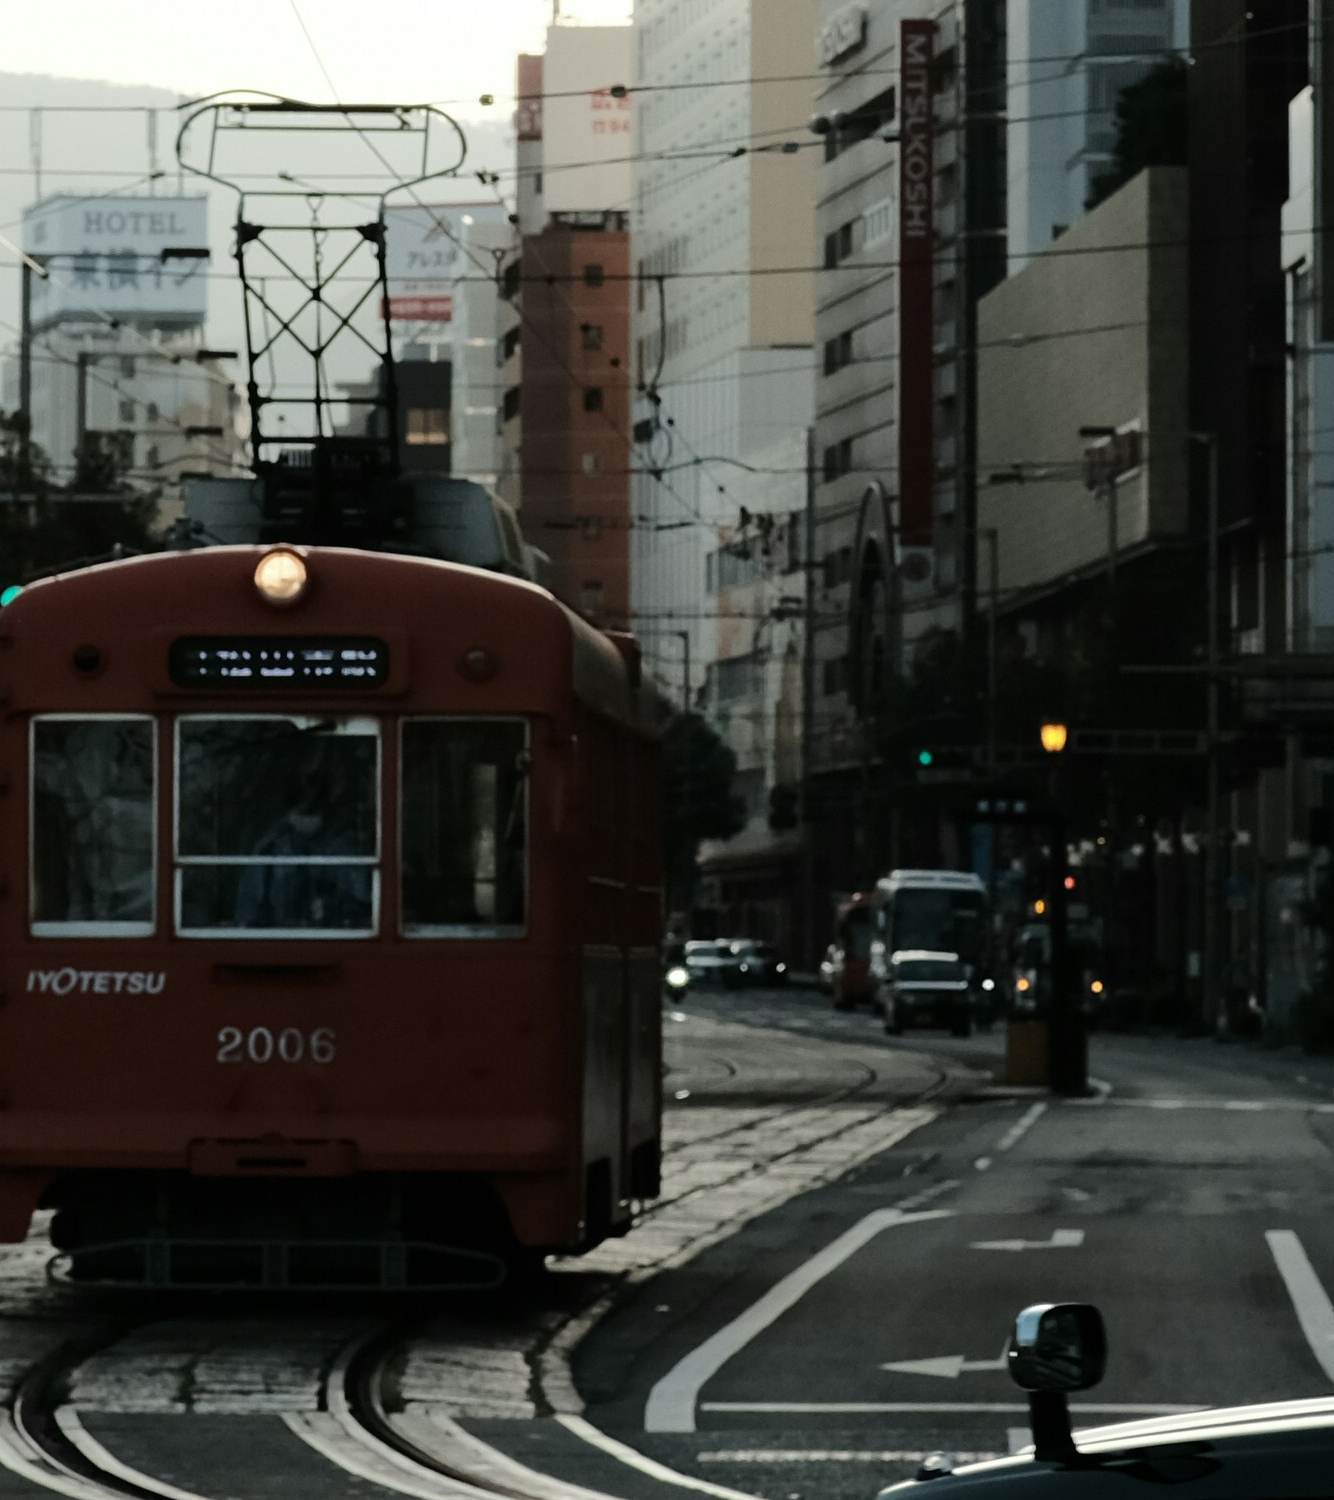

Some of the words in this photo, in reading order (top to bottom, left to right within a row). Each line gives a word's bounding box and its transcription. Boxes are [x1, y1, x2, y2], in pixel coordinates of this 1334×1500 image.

[904, 31, 929, 237] MITSUKOSHI
[83, 211, 186, 234] HOTEL
[26, 967, 167, 996] IYOTETSU
[217, 1026, 337, 1064] 2006
